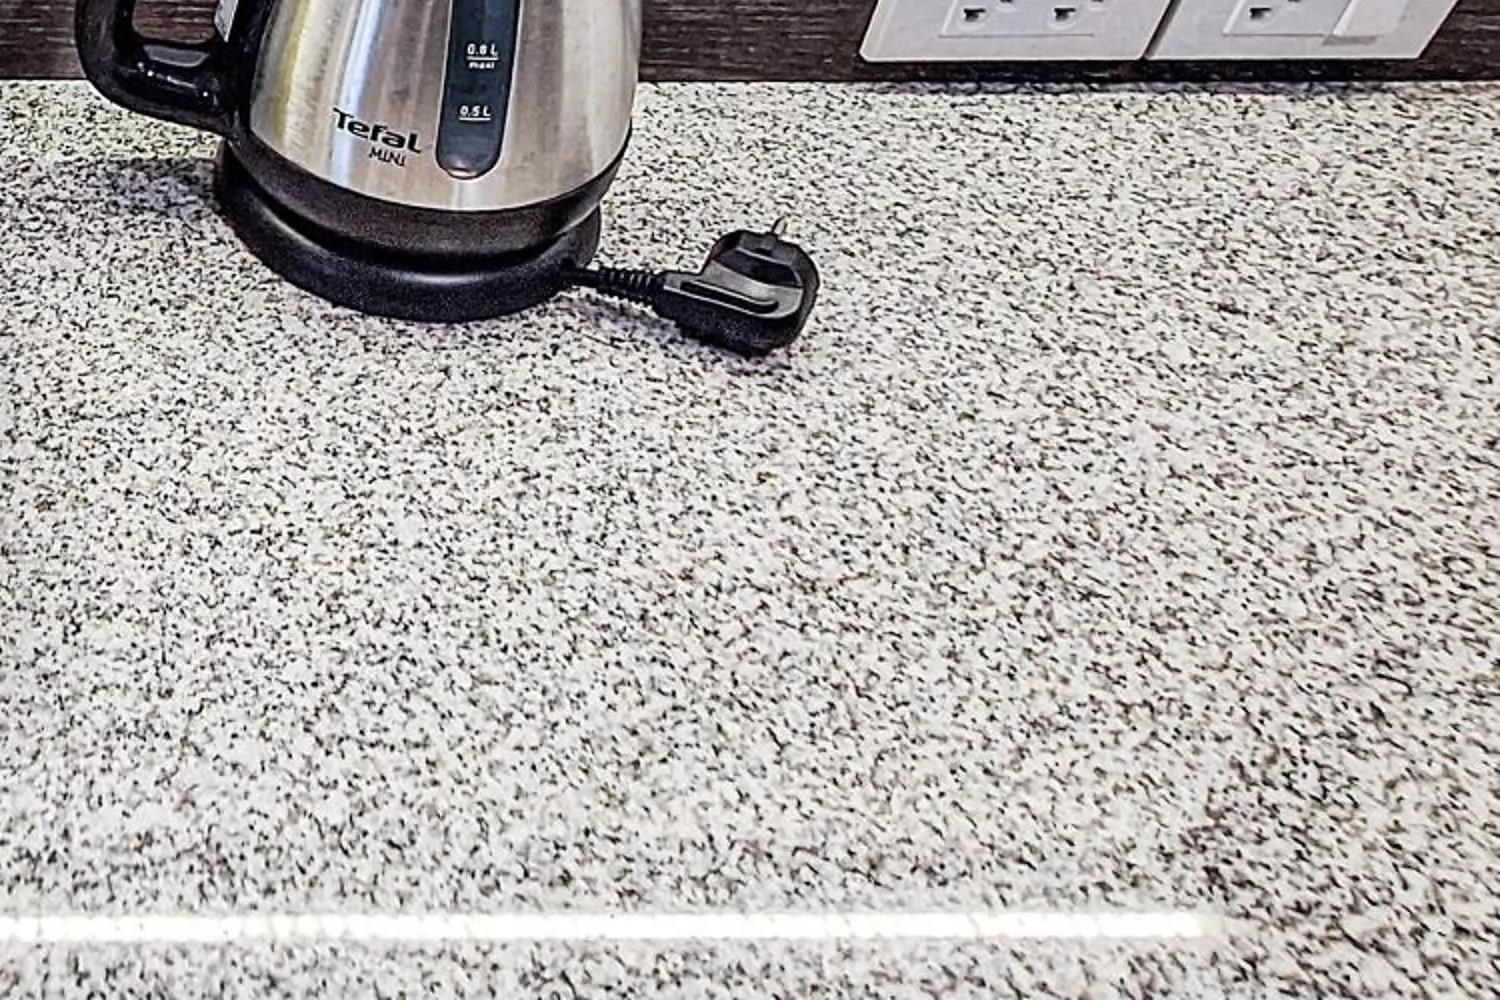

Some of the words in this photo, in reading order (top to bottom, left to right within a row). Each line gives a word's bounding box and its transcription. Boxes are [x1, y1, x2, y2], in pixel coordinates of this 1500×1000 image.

[483, 105, 491, 117] L
[332, 107, 422, 154] Tefal
[368, 146, 406, 167] MINI
